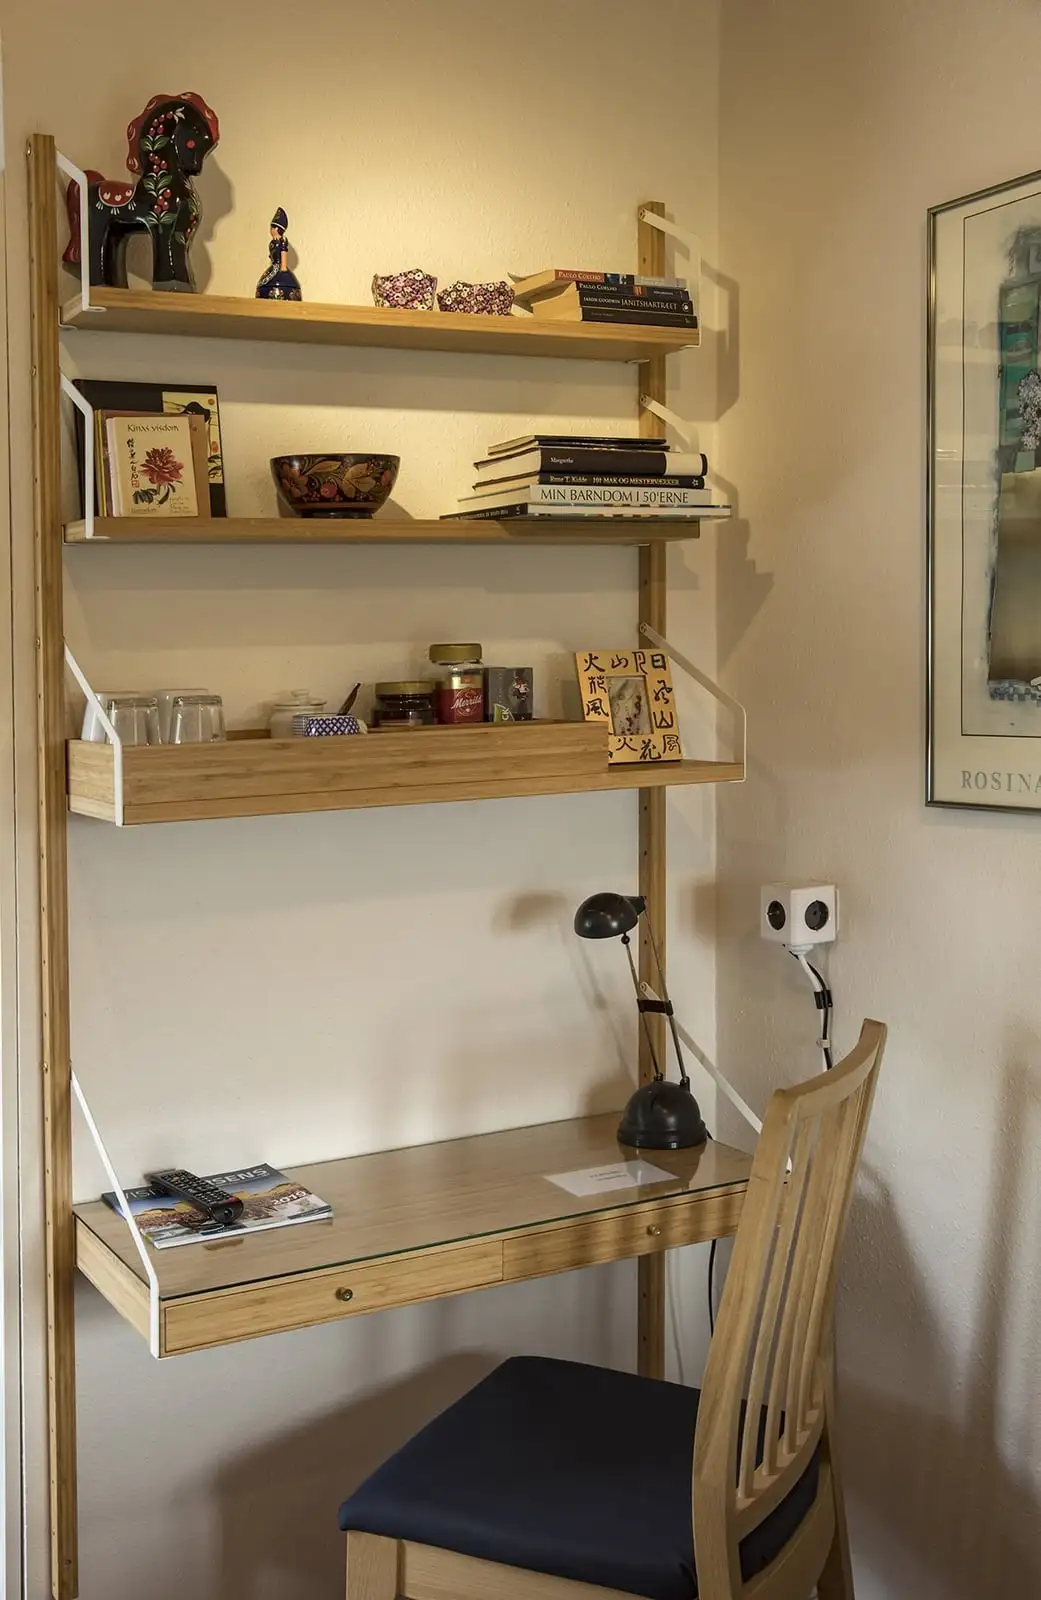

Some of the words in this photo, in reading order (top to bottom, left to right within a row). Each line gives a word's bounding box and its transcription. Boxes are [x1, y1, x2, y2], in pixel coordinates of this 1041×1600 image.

[540, 488, 567, 501] MIN
[570, 489, 633, 502] BARNDOM
[636, 491, 640, 502] I
[271, 1190, 306, 1207] 2019
